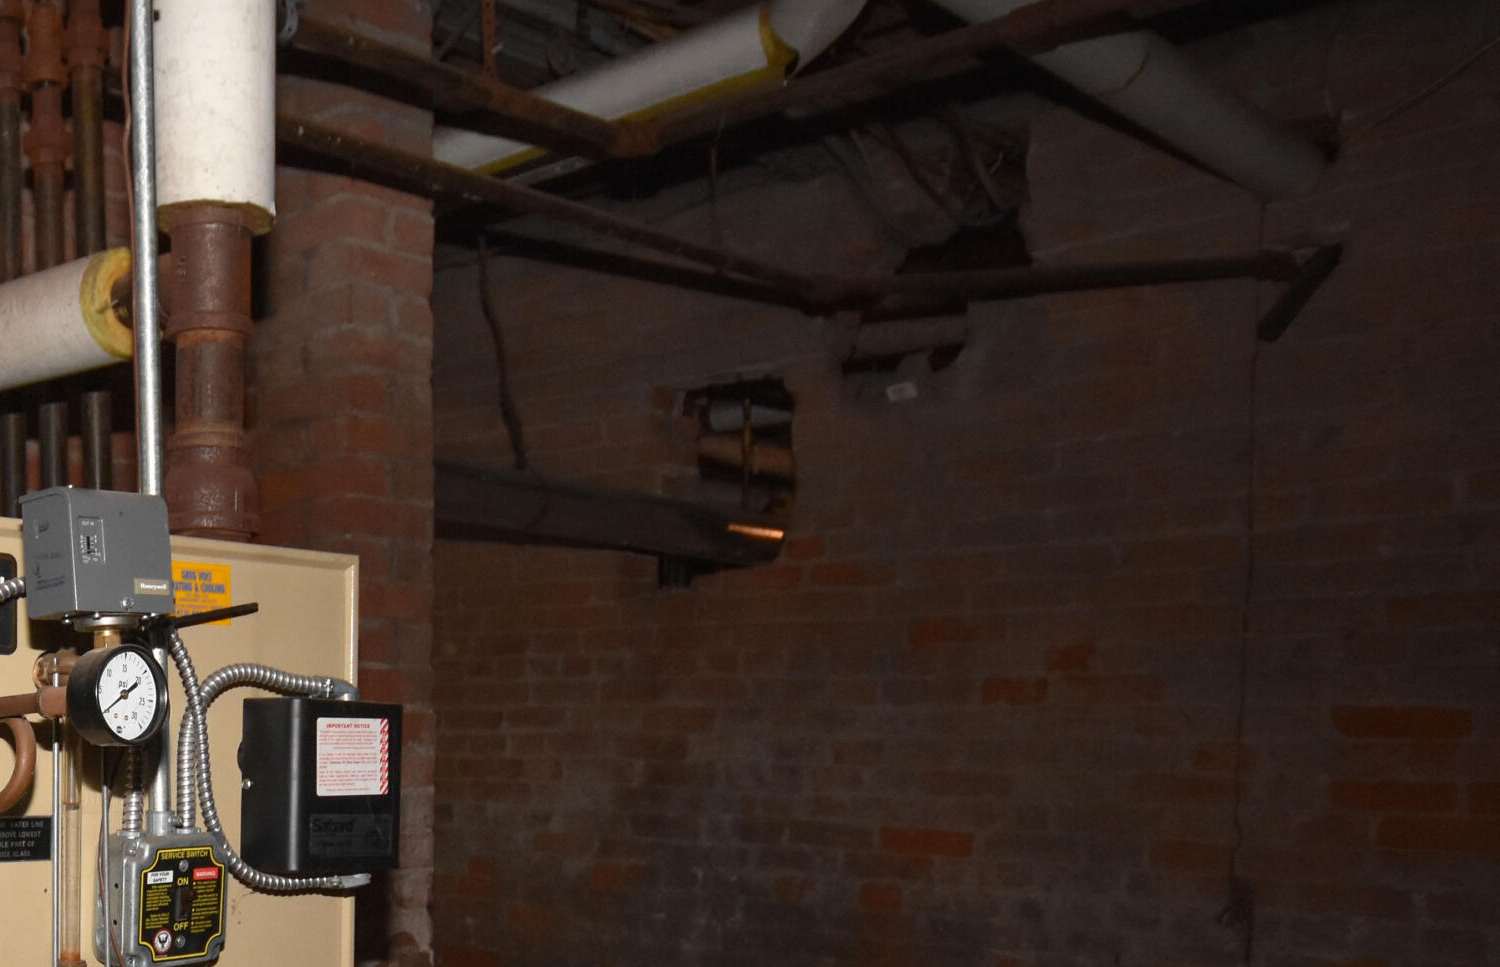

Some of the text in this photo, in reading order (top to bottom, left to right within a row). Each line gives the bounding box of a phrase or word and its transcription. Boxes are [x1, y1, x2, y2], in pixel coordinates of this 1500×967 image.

[139, 582, 167, 591] Honeywell
[122, 664, 128, 673] 15
[139, 697, 146, 706] 25
[161, 850, 208, 860] SERVICE SWITCH
[177, 877, 189, 886] ON
[173, 921, 189, 931] OFF
